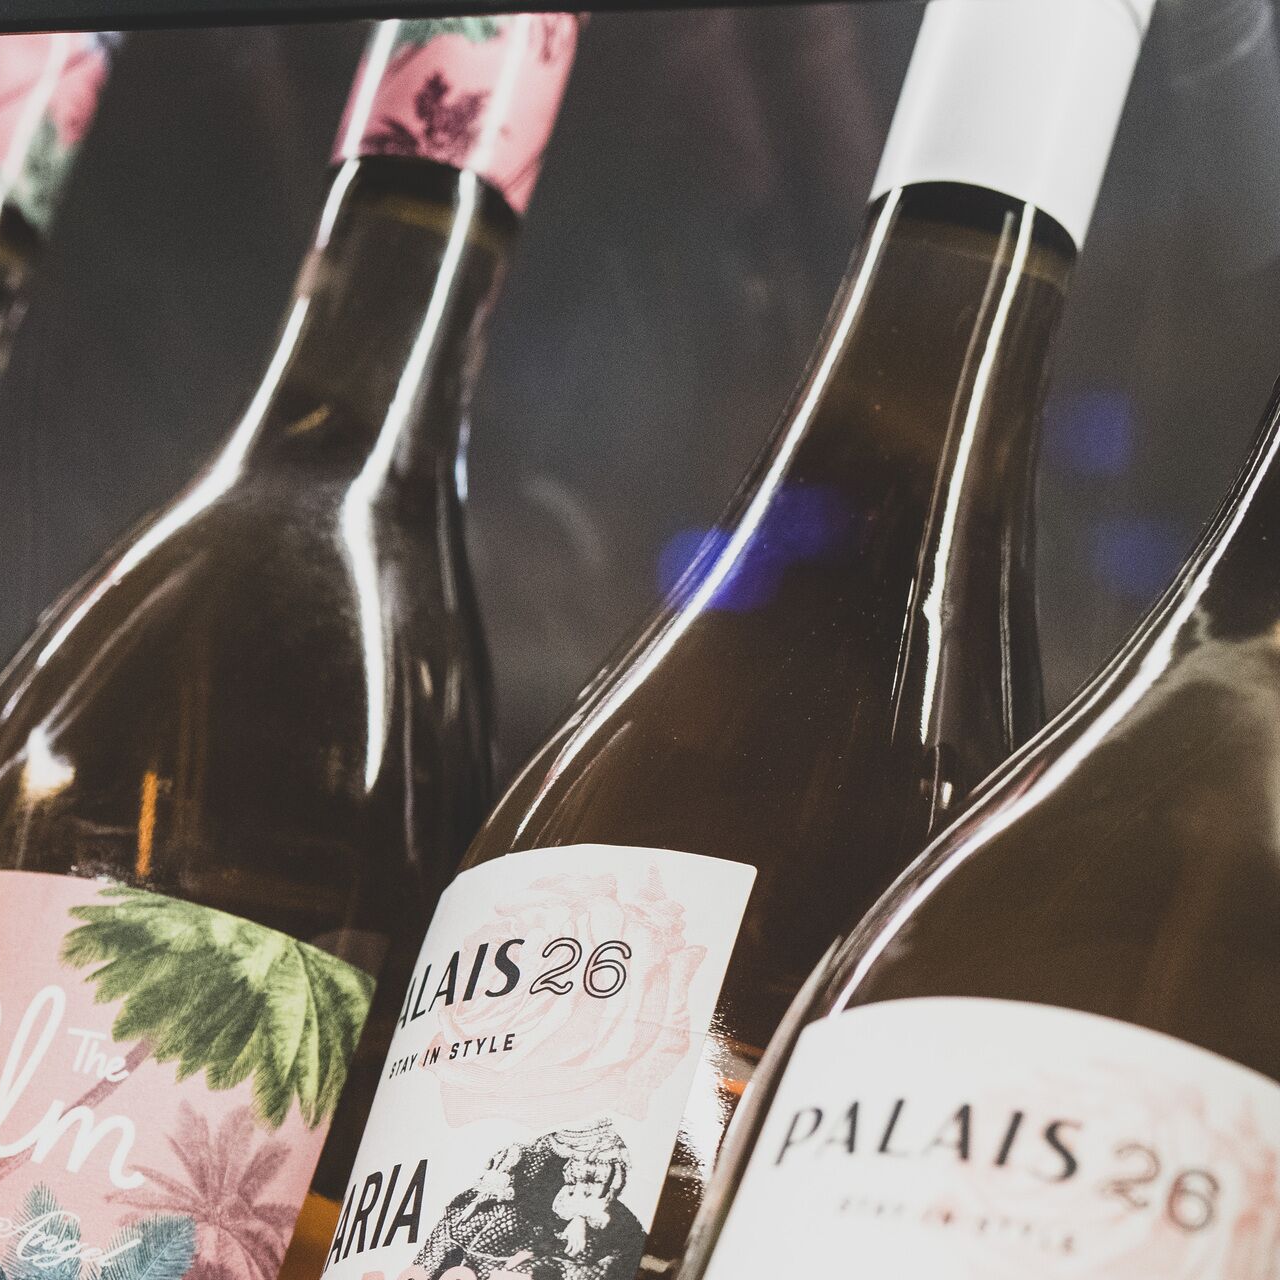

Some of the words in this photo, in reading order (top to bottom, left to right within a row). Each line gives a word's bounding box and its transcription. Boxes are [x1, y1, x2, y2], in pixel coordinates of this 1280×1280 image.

[529, 936, 633, 999] 26
[67, 1026, 129, 1083] The
[389, 1054, 418, 1080] STAY
[422, 1046, 441, 1068] IN
[448, 1033, 517, 1061] STYLE
[773, 1097, 1086, 1184] PALAIS
[1103, 1142, 1227, 1234] 26
